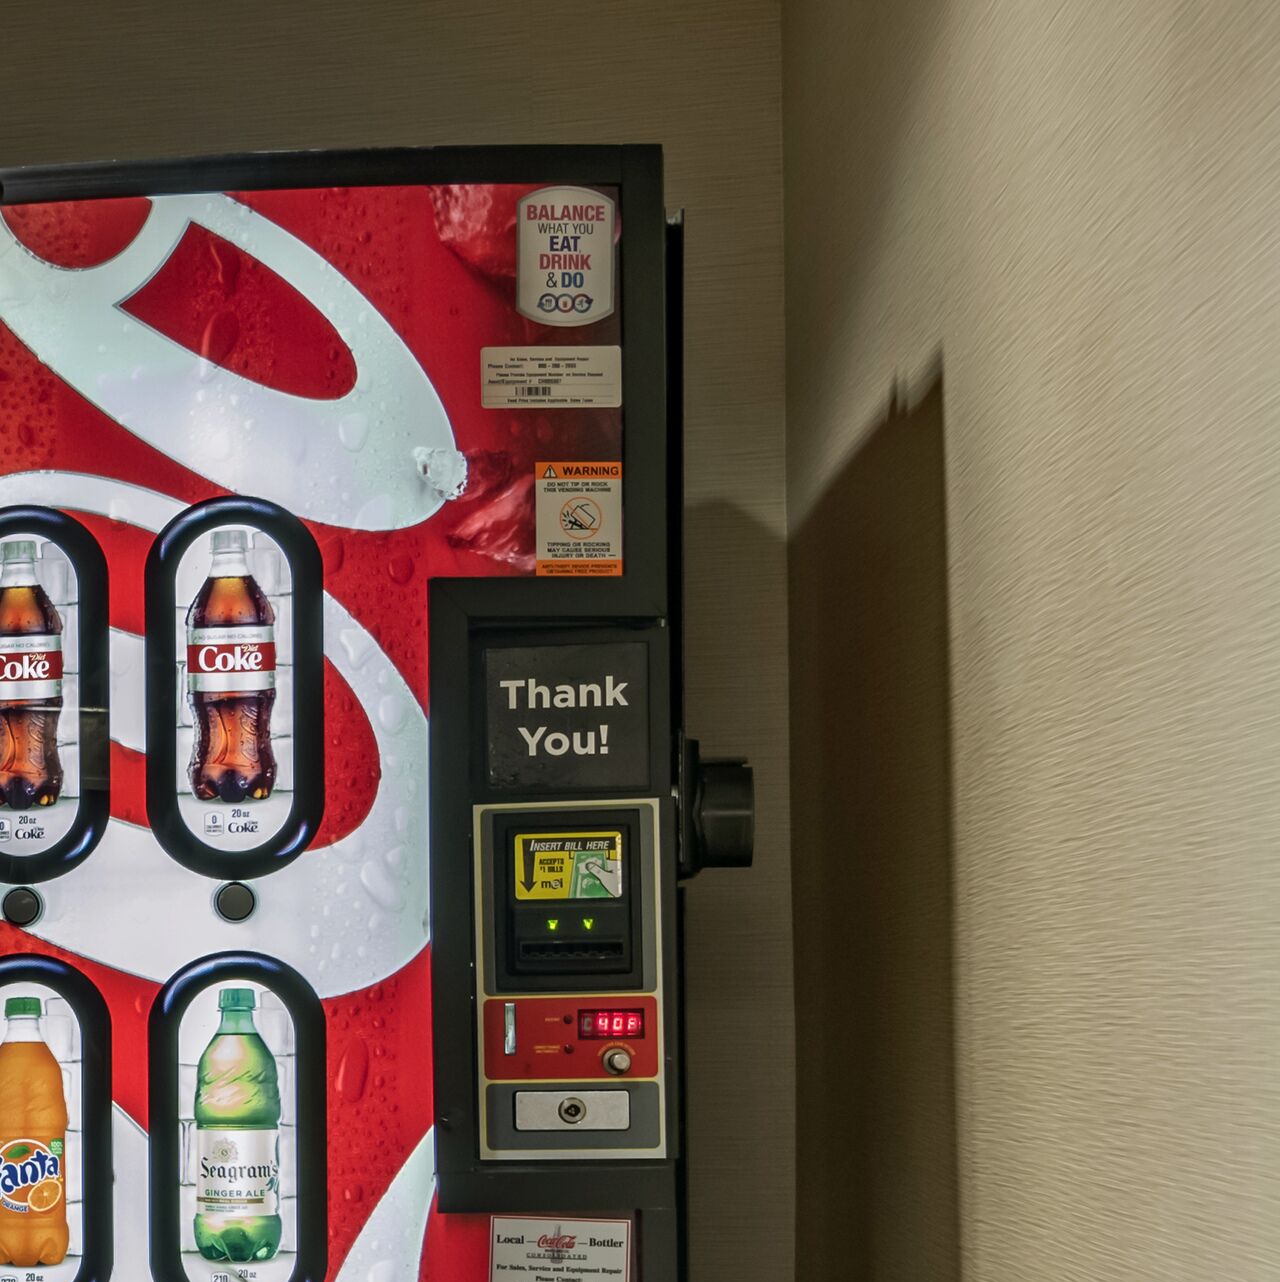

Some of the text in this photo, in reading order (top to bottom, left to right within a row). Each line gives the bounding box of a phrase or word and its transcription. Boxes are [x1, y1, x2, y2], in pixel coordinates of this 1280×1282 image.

[526, 204, 606, 222] BALANCE
[538, 222, 593, 235] WHAT YOU
[539, 254, 591, 270] DRINK
[546, 271, 584, 288] & DO
[562, 466, 619, 476] WARNING
[198, 647, 262, 672] Coke
[500, 676, 629, 709] Thank
[519, 725, 610, 757] You!
[18, 816, 28, 825] 20
[15, 828, 46, 839] Coke
[228, 822, 259, 833] Coke
[530, 840, 610, 851] INSERT BILL HERE
[200, 1156, 279, 1183] Seagram's
[205, 1189, 242, 1197] GINGER
[496, 1234, 525, 1245] Local
[589, 1237, 624, 1248] Bottler
[565, 1267, 600, 1275] Equipment
